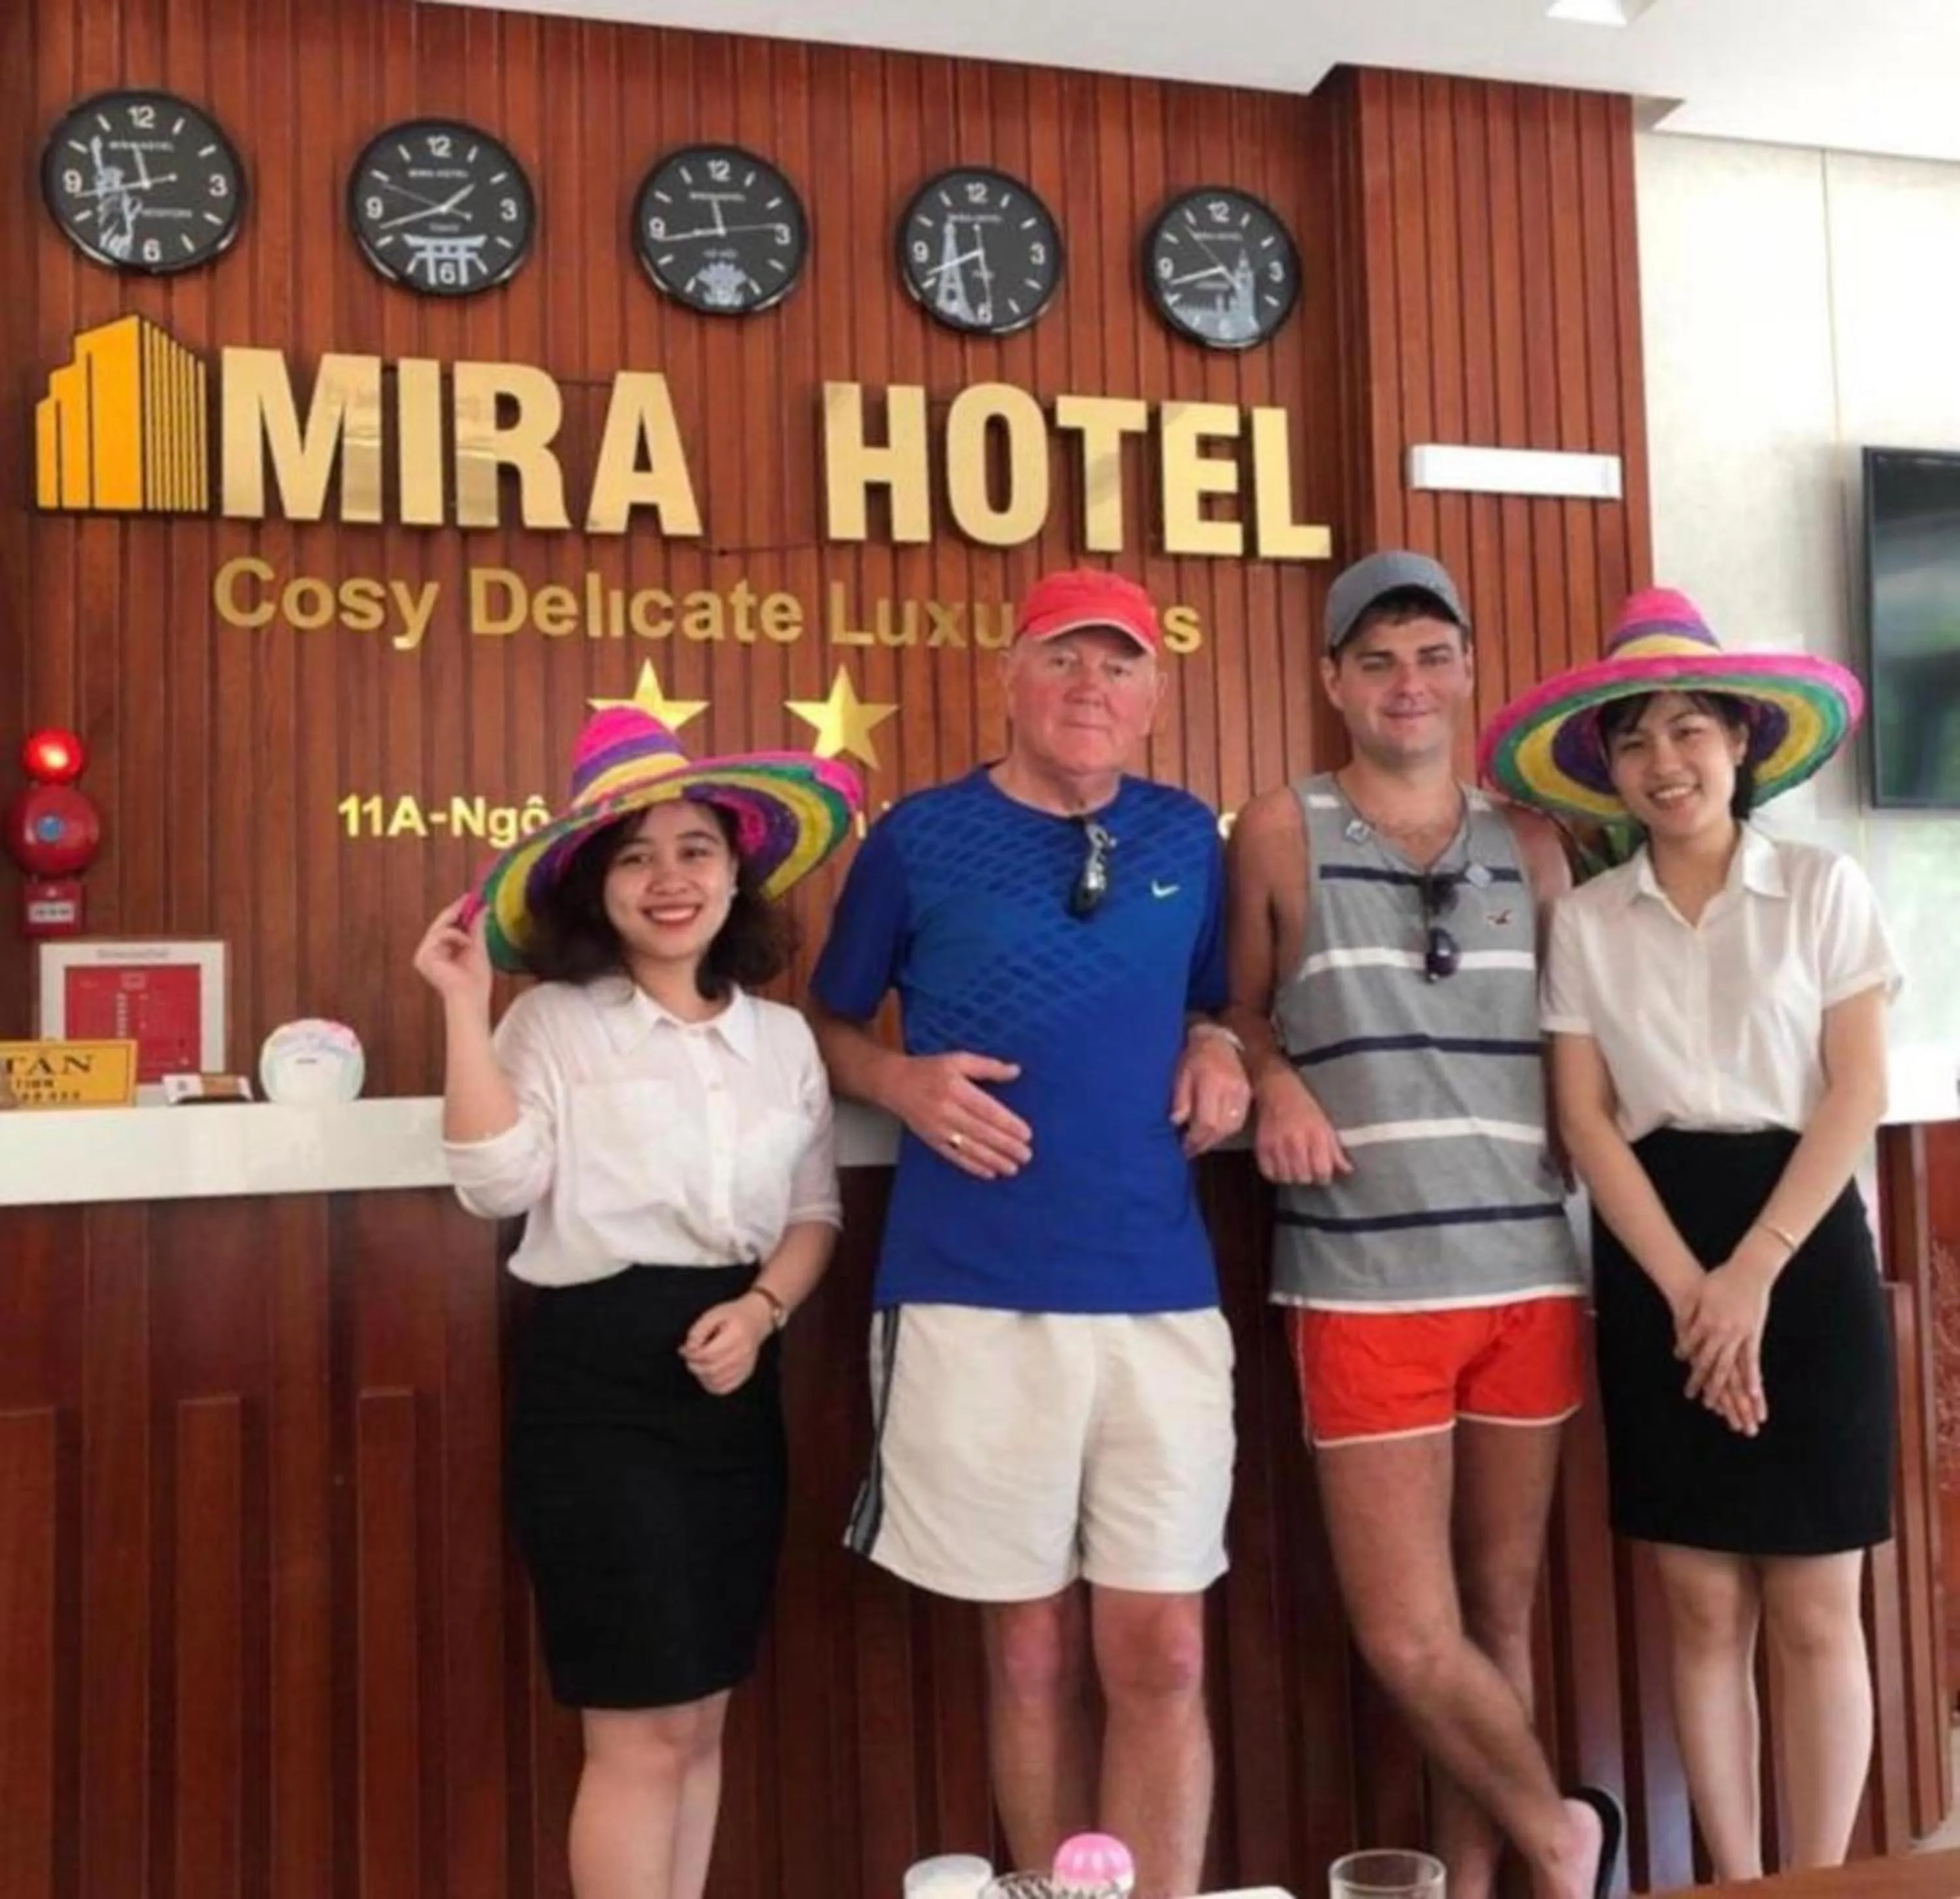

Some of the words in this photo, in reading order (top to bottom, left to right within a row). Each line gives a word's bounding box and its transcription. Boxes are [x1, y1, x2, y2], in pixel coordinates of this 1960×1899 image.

[127, 105, 156, 129] 12
[427, 135, 452, 158] 12
[63, 169, 82, 193] 9
[707, 159, 731, 182] 12
[209, 173, 228, 197] 3
[964, 182, 988, 204] 12
[365, 196, 384, 220] 9
[500, 198, 518, 222] 3
[1206, 201, 1230, 223] 12
[649, 217, 666, 241] 9
[774, 223, 791, 245] 3
[143, 238, 161, 262] 6
[912, 240, 930, 263] 9
[1030, 241, 1045, 265] 3
[438, 262, 456, 284] 6
[1157, 257, 1175, 280] 9
[1267, 260, 1285, 283] 3
[221, 346, 704, 537] MIRA
[823, 381, 1333, 559] HOTEL
[214, 557, 440, 651] Cosy
[470, 567, 803, 644] Delicate
[830, 581, 1201, 654] Luxus
